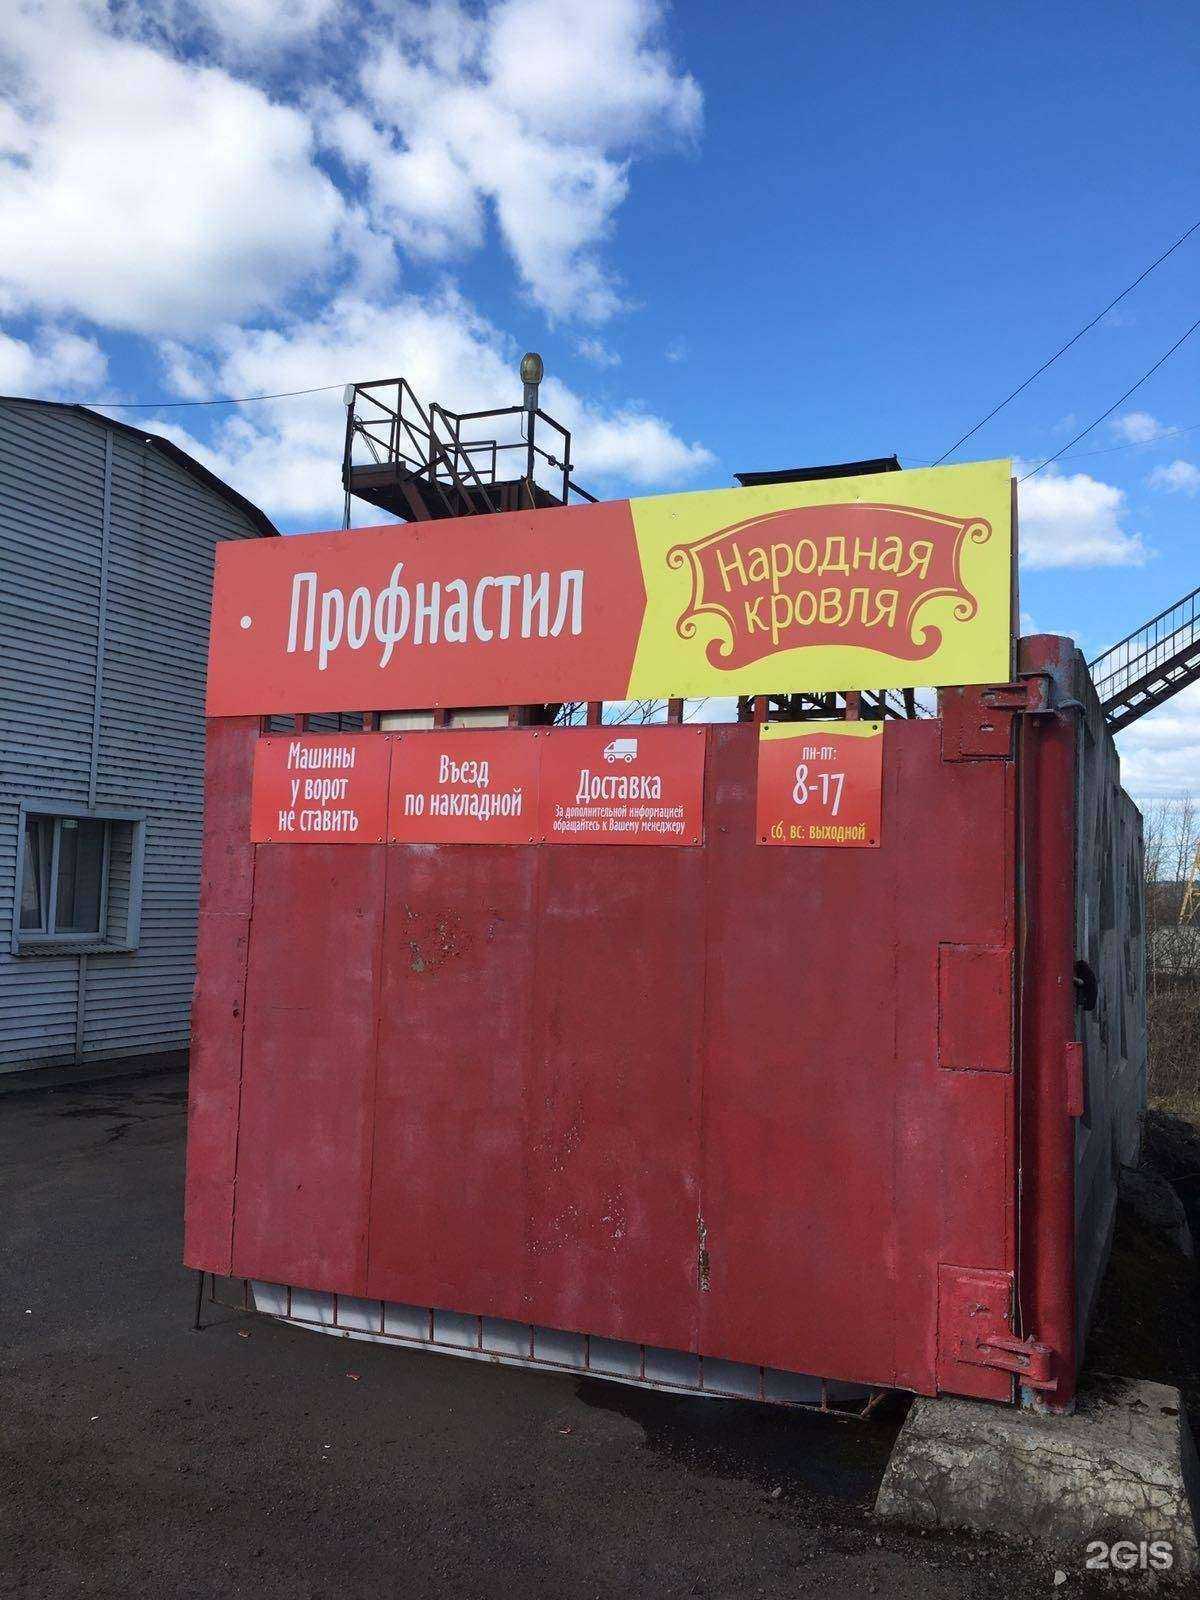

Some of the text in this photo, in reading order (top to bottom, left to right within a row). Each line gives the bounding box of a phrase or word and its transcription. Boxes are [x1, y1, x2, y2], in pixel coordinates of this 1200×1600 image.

[716, 536, 934, 593] Народная
[286, 562, 584, 671] Профнастил
[744, 587, 899, 645] кровля
[287, 742, 356, 769] Машины
[438, 754, 489, 787] Въезд
[291, 778, 348, 806] у ворот
[576, 769, 661, 804] Доставка
[792, 764, 845, 816] 8-17
[278, 809, 359, 831] не ставить
[404, 787, 522, 820] по накладной
[555, 805, 683, 820] За дополнительной информацией
[553, 818, 685, 834] обращайтесь к Вашему менеджеру
[809, 823, 866, 842] выходной
